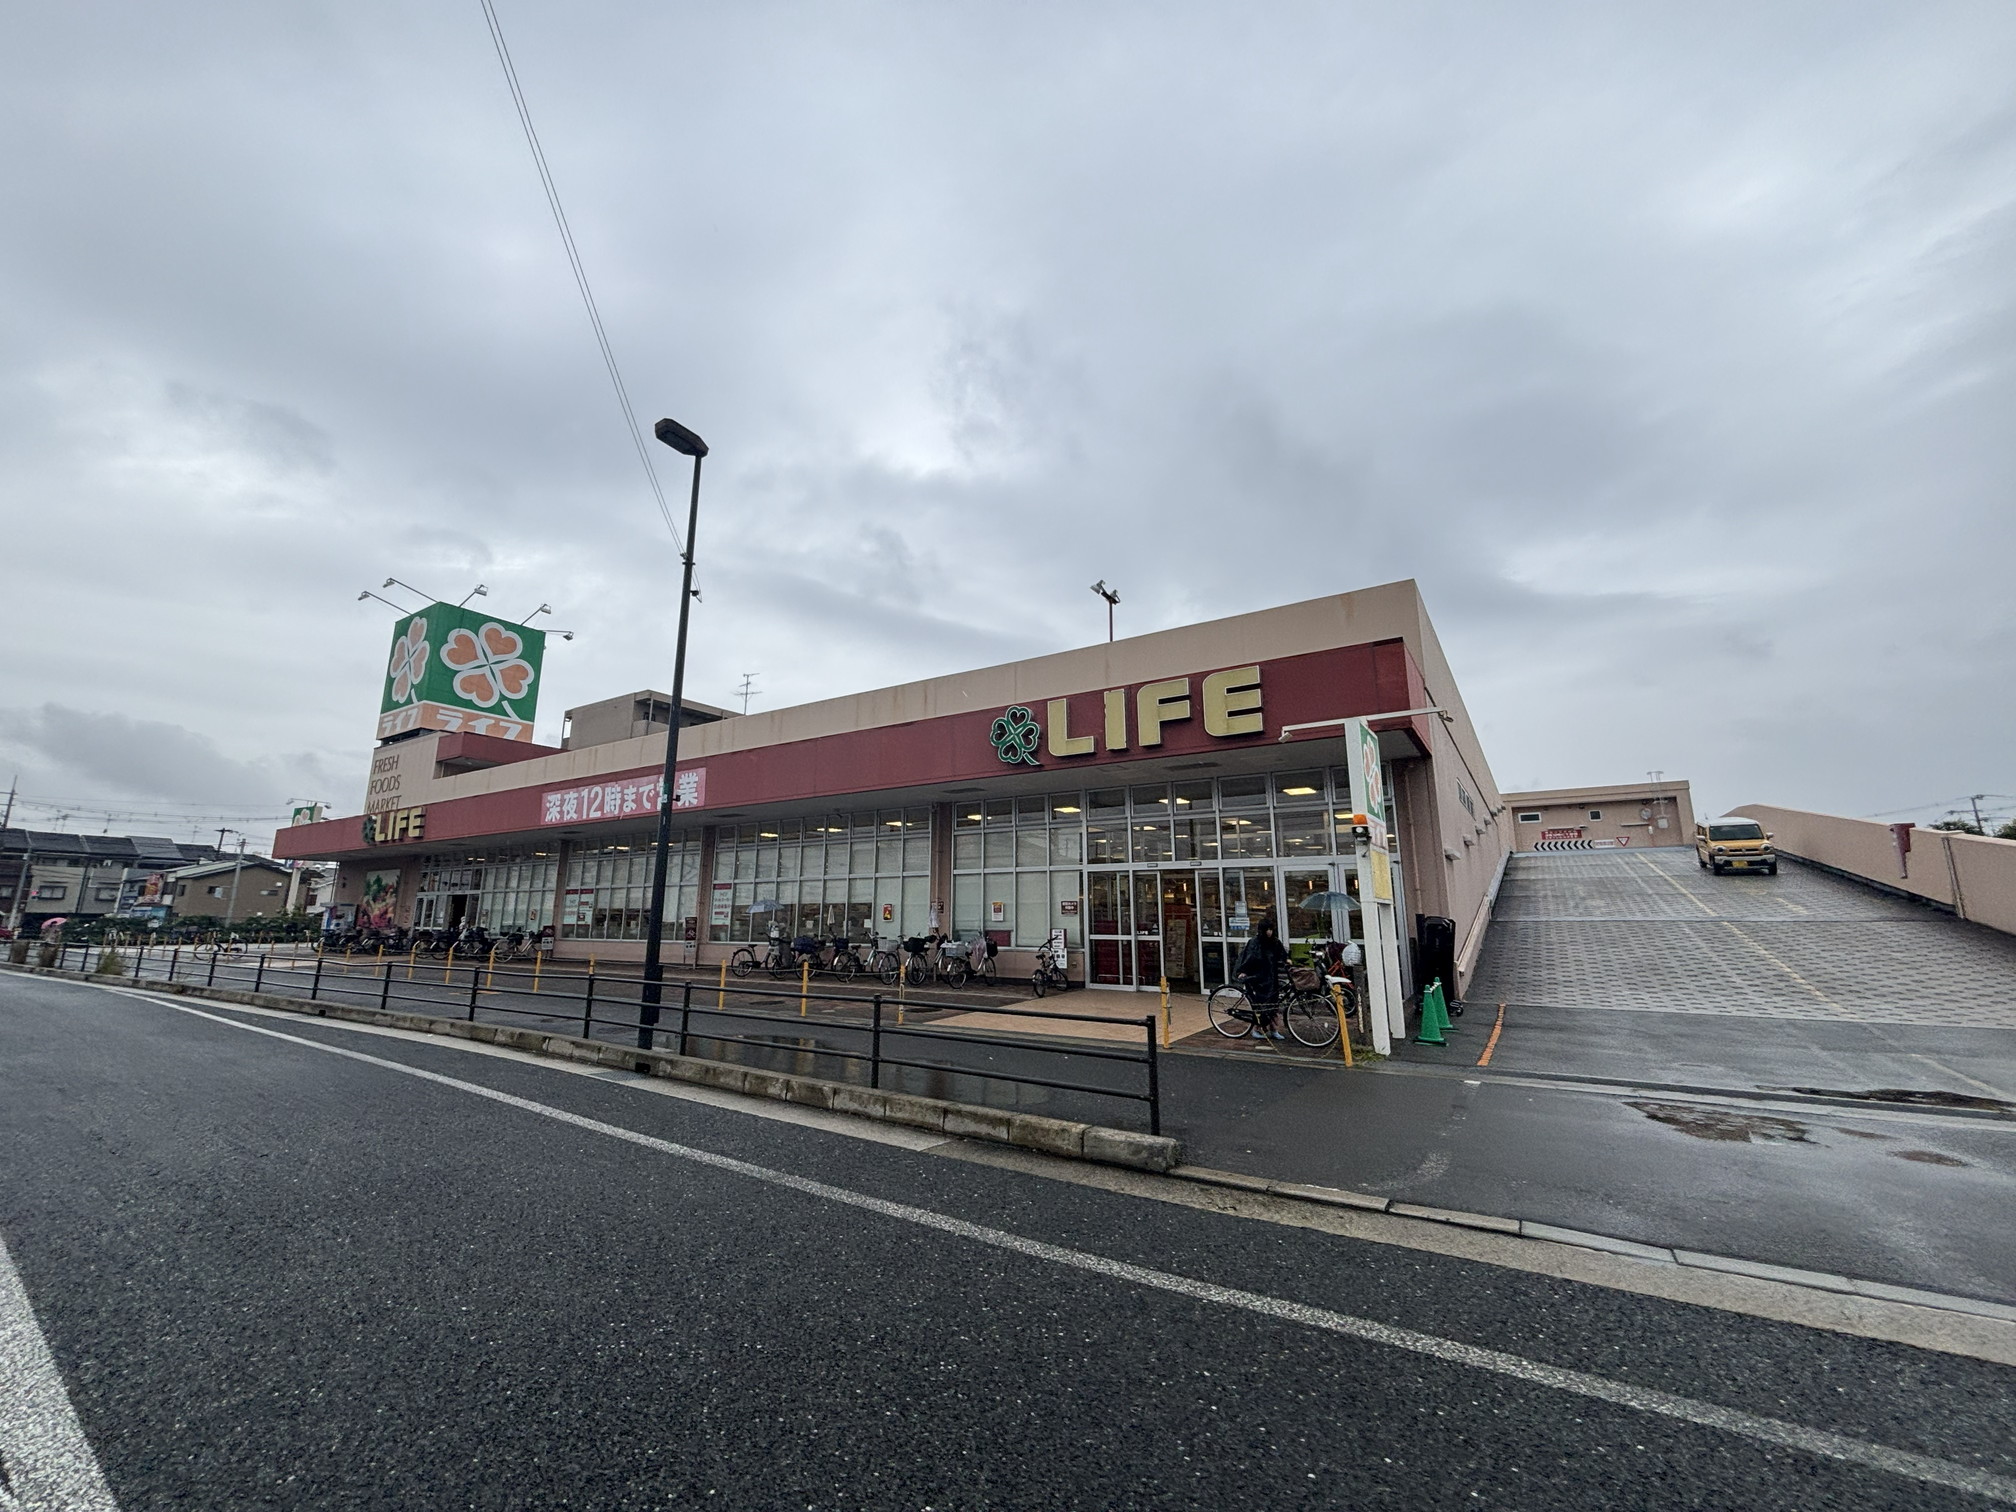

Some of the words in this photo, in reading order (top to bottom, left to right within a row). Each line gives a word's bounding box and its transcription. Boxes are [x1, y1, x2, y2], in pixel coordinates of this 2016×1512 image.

[382, 707, 419, 736] ライフ
[436, 708, 522, 740] ライフ
[1047, 665, 1264, 757] LIFE
[373, 755, 400, 775] FRESH
[370, 774, 401, 796] FOODS
[367, 795, 402, 813] MARKET
[374, 806, 424, 842] LIFE
